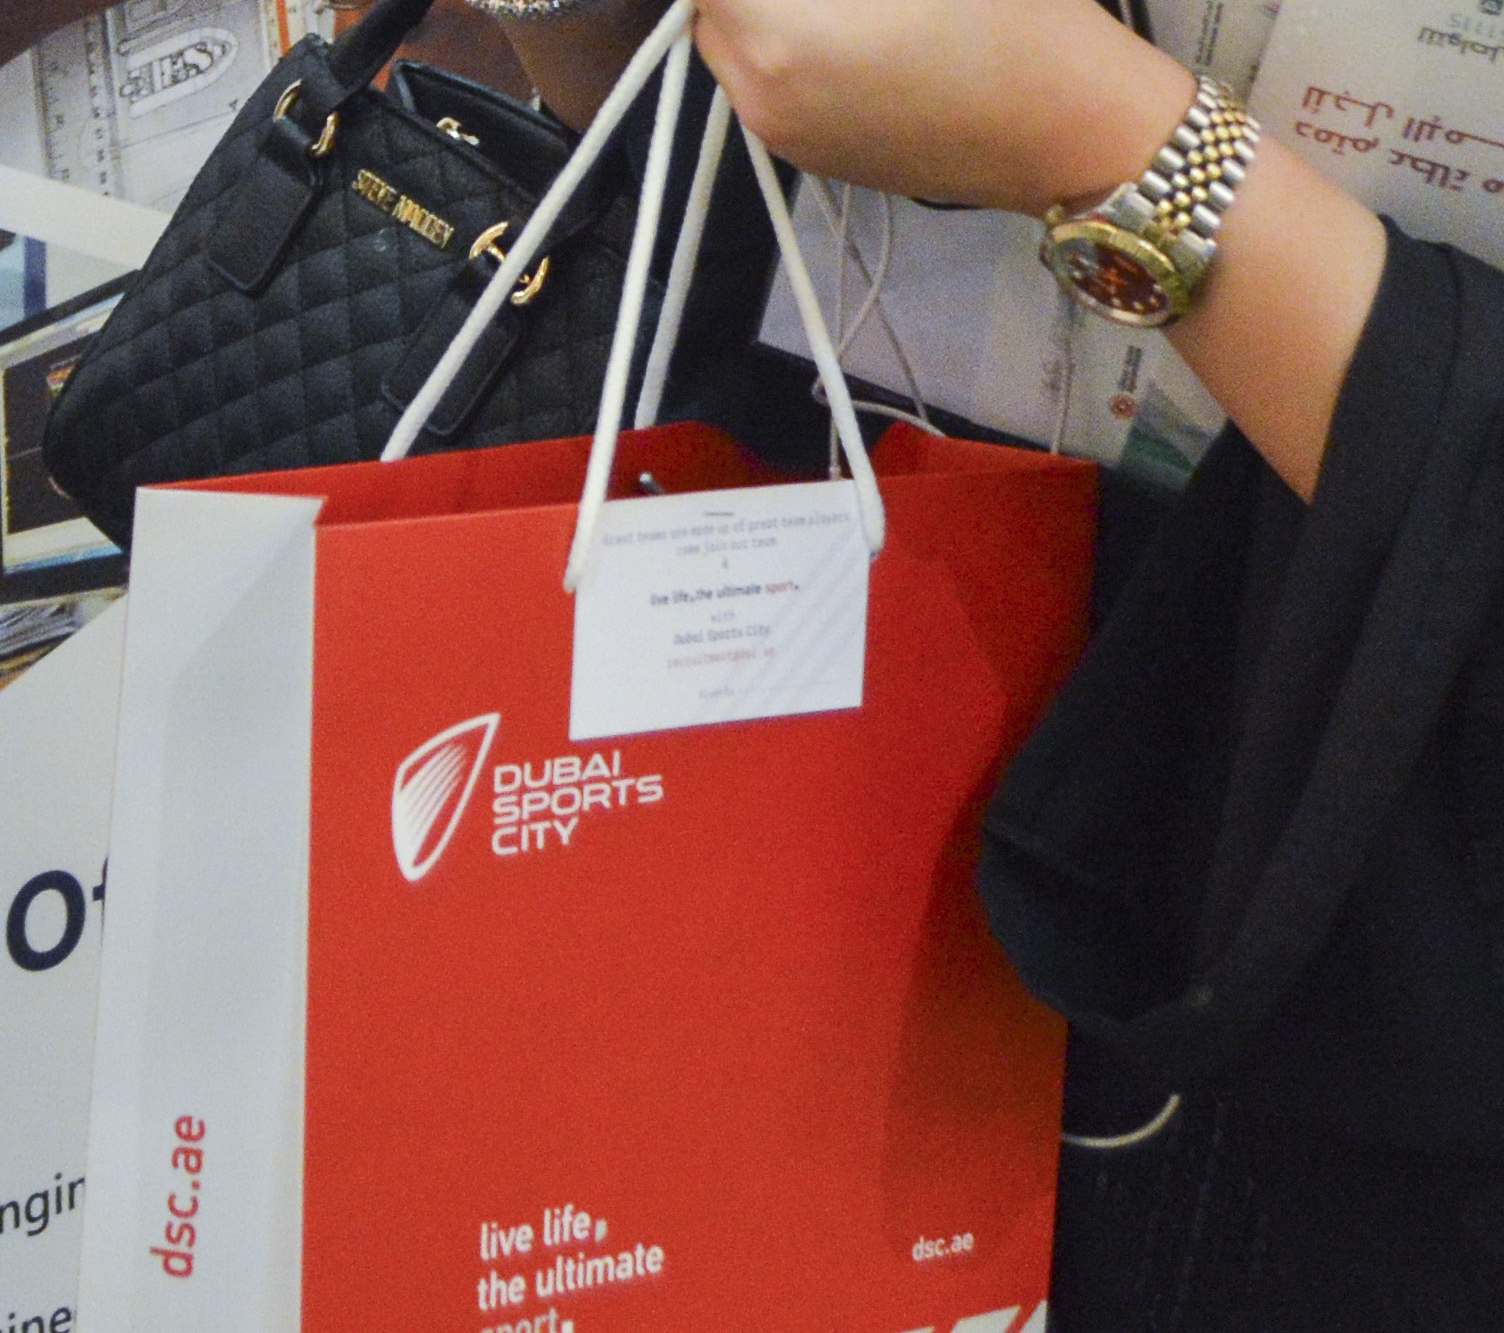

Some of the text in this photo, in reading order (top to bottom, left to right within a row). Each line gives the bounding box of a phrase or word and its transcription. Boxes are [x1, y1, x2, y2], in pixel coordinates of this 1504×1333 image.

[1294, 119, 1380, 156] دمتم
[494, 750, 620, 794] DUBAI
[493, 774, 664, 825] SPORTS
[492, 817, 579, 855] CITY
[150, 1115, 205, 1277] dsc.ae
[479, 1220, 534, 1261] live
[911, 1232, 976, 1262] dsc.ae
[477, 1243, 664, 1311] the ultimate
